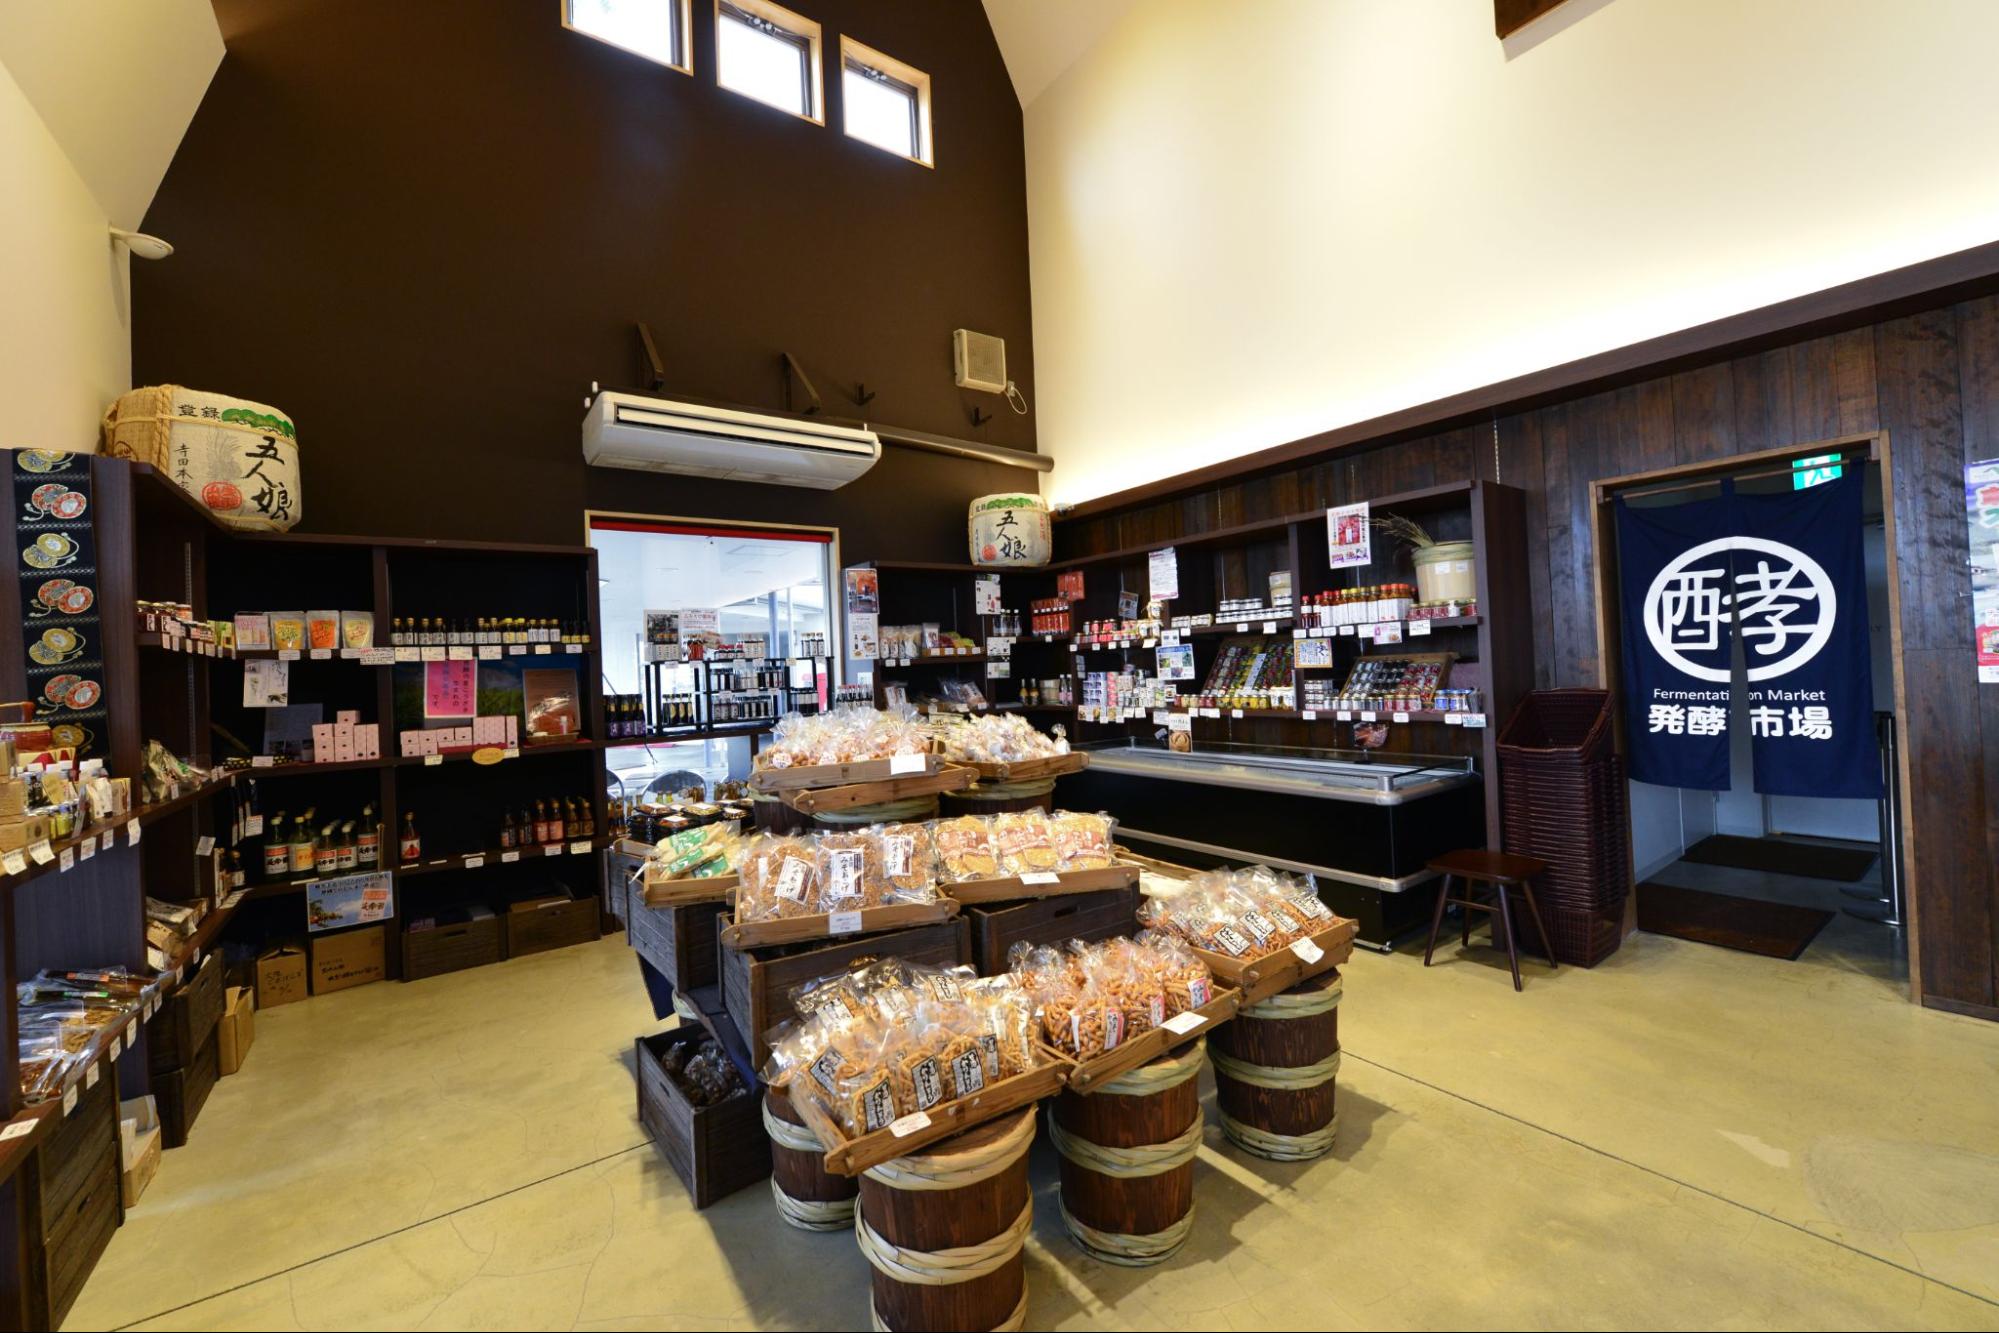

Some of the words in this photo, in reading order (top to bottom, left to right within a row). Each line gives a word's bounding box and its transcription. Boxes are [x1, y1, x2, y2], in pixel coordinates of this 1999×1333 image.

[178, 403, 220, 420] 登録
[241, 435, 292, 520] 五人娘
[995, 510, 1027, 560] 五人娘
[1653, 688, 1763, 701] Fermentation
[1768, 690, 1826, 701] Market
[1648, 703, 1833, 740] 発酵市場
